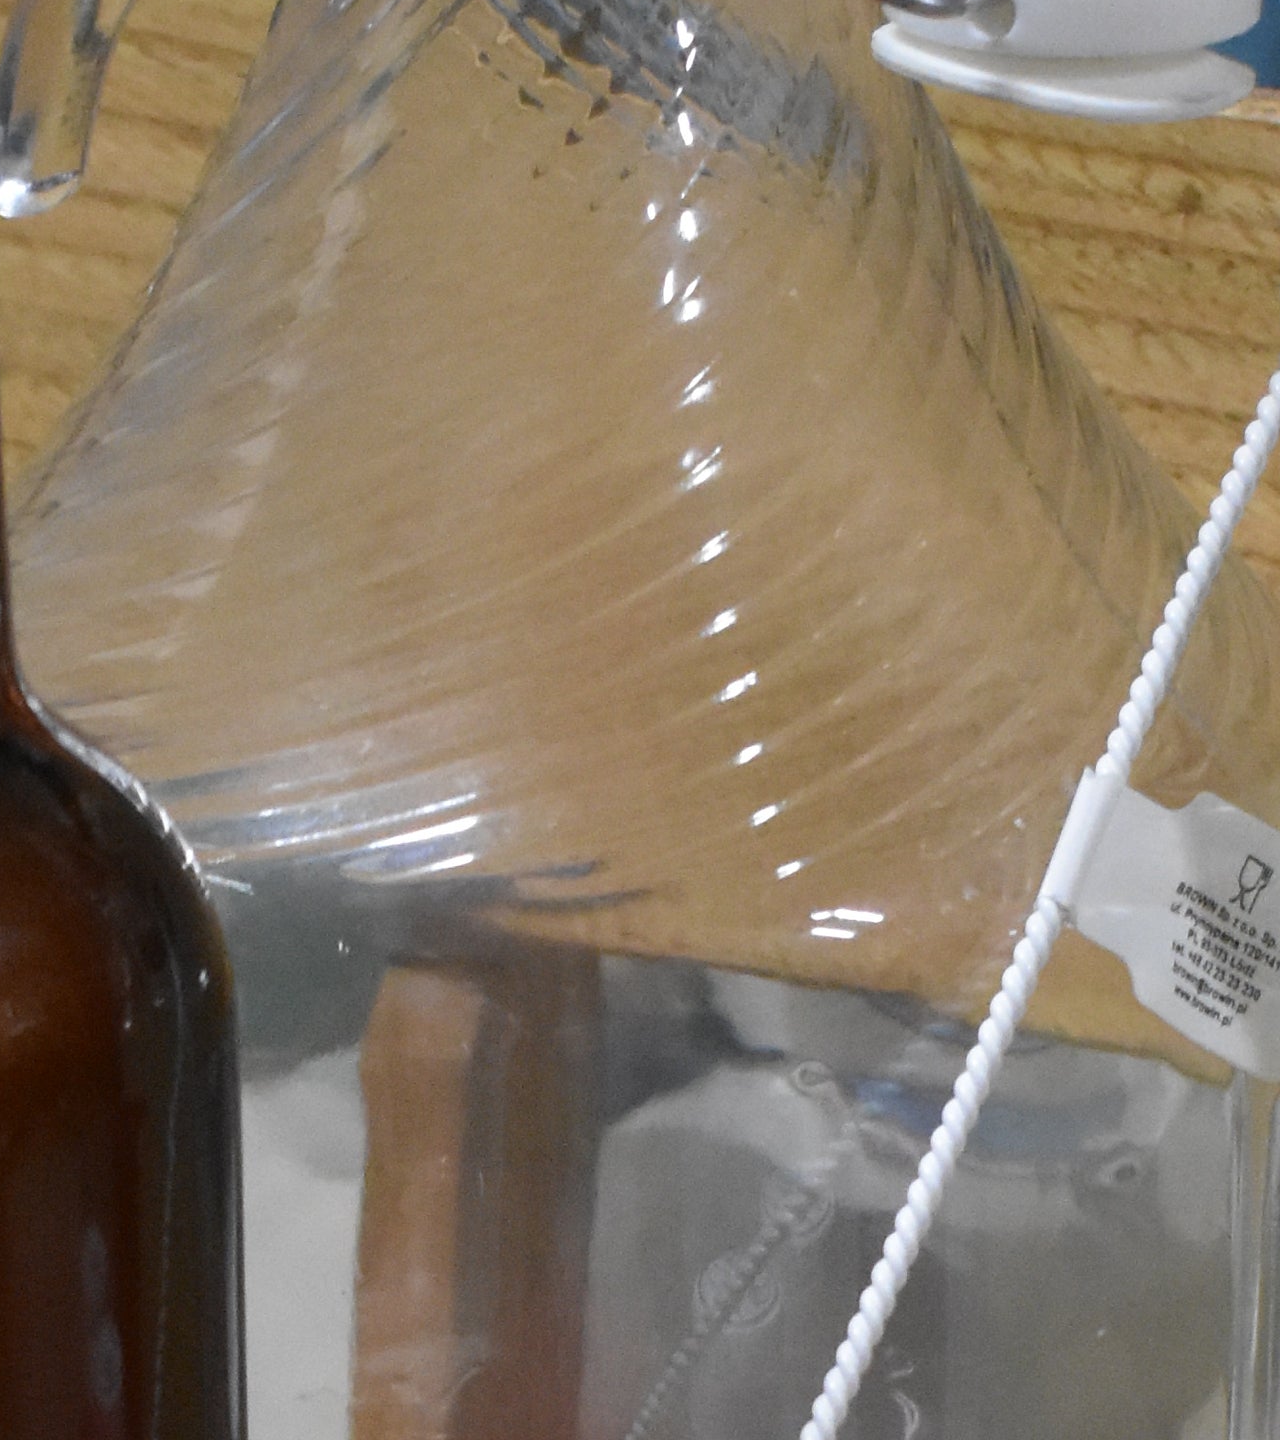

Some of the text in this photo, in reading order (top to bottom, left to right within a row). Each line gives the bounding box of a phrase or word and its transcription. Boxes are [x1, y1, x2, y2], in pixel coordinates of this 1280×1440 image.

[1176, 882, 1219, 913] BROWIN
[1261, 931, 1276, 948] Sp.
[1174, 985, 1234, 1028] www.browin.pl
[1227, 973, 1241, 991] 23
[1241, 981, 1262, 1002] 230
